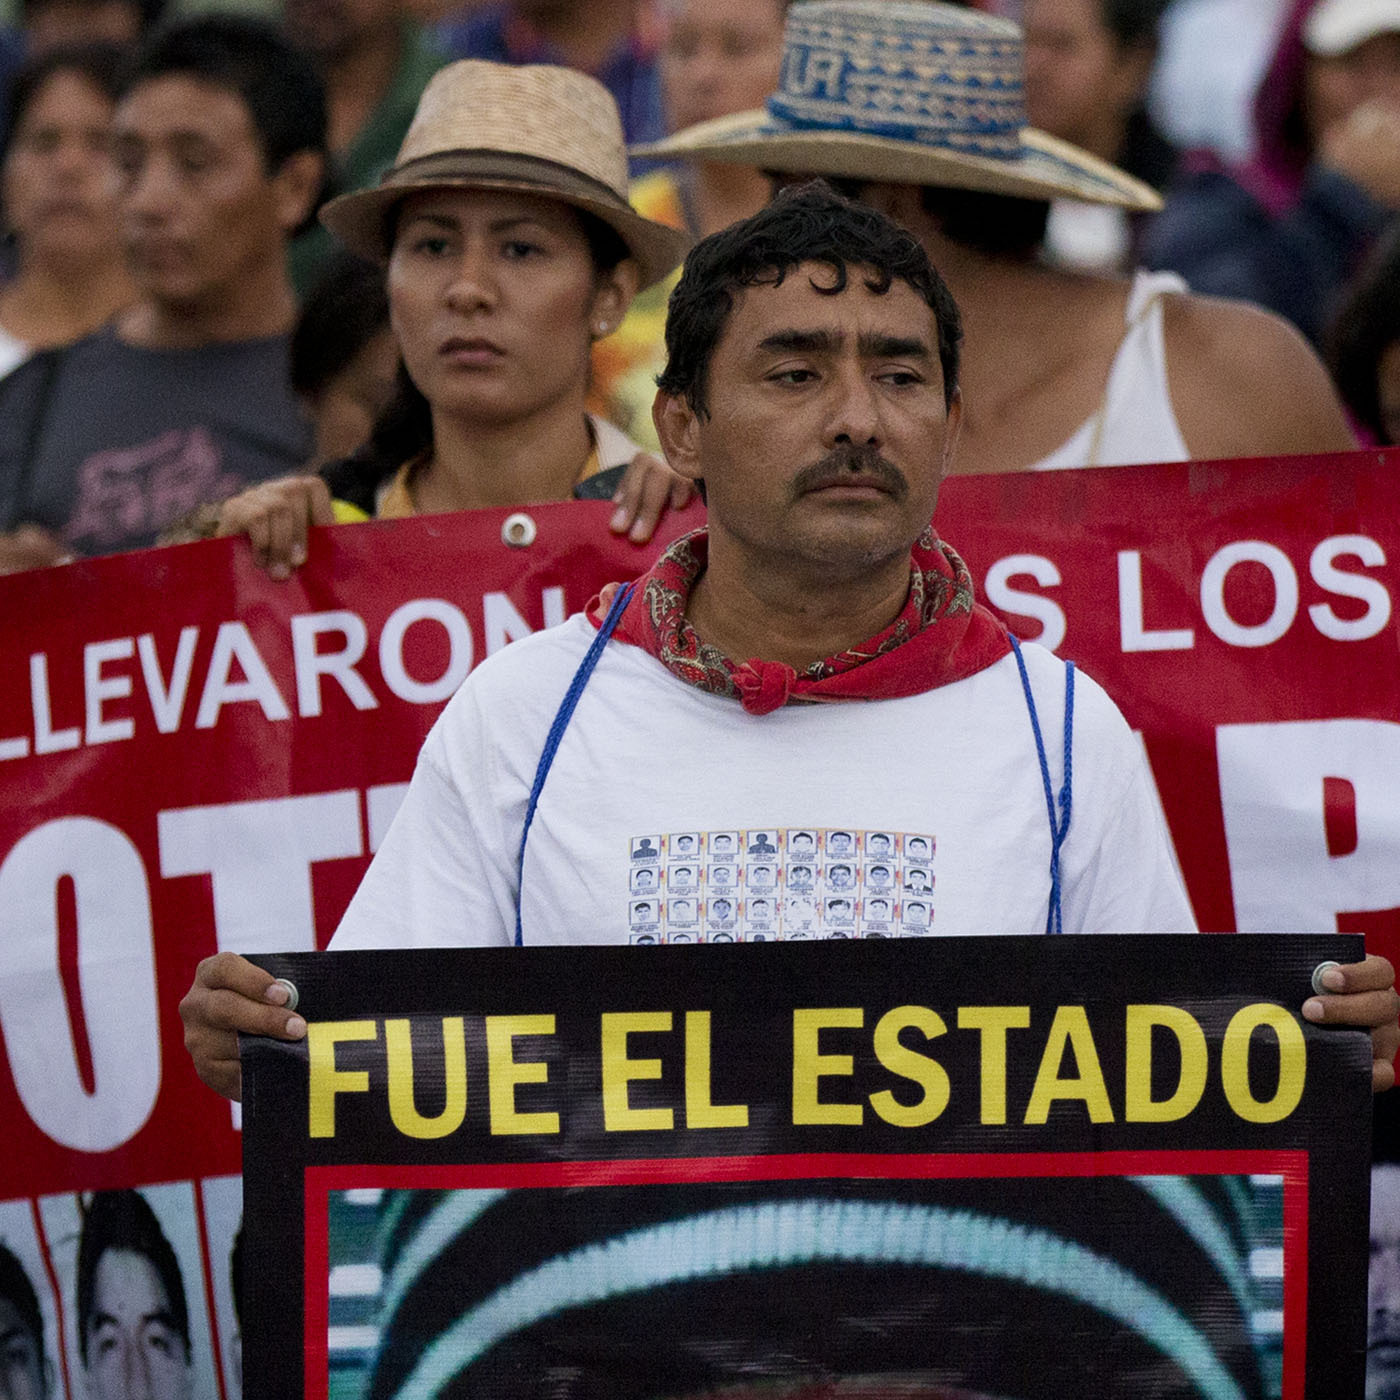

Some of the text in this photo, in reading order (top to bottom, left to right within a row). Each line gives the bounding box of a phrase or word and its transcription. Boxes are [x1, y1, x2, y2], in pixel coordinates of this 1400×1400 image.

[1117, 533, 1393, 653] LOS
[308, 1002, 1308, 1140] FUE EL ESTADO
